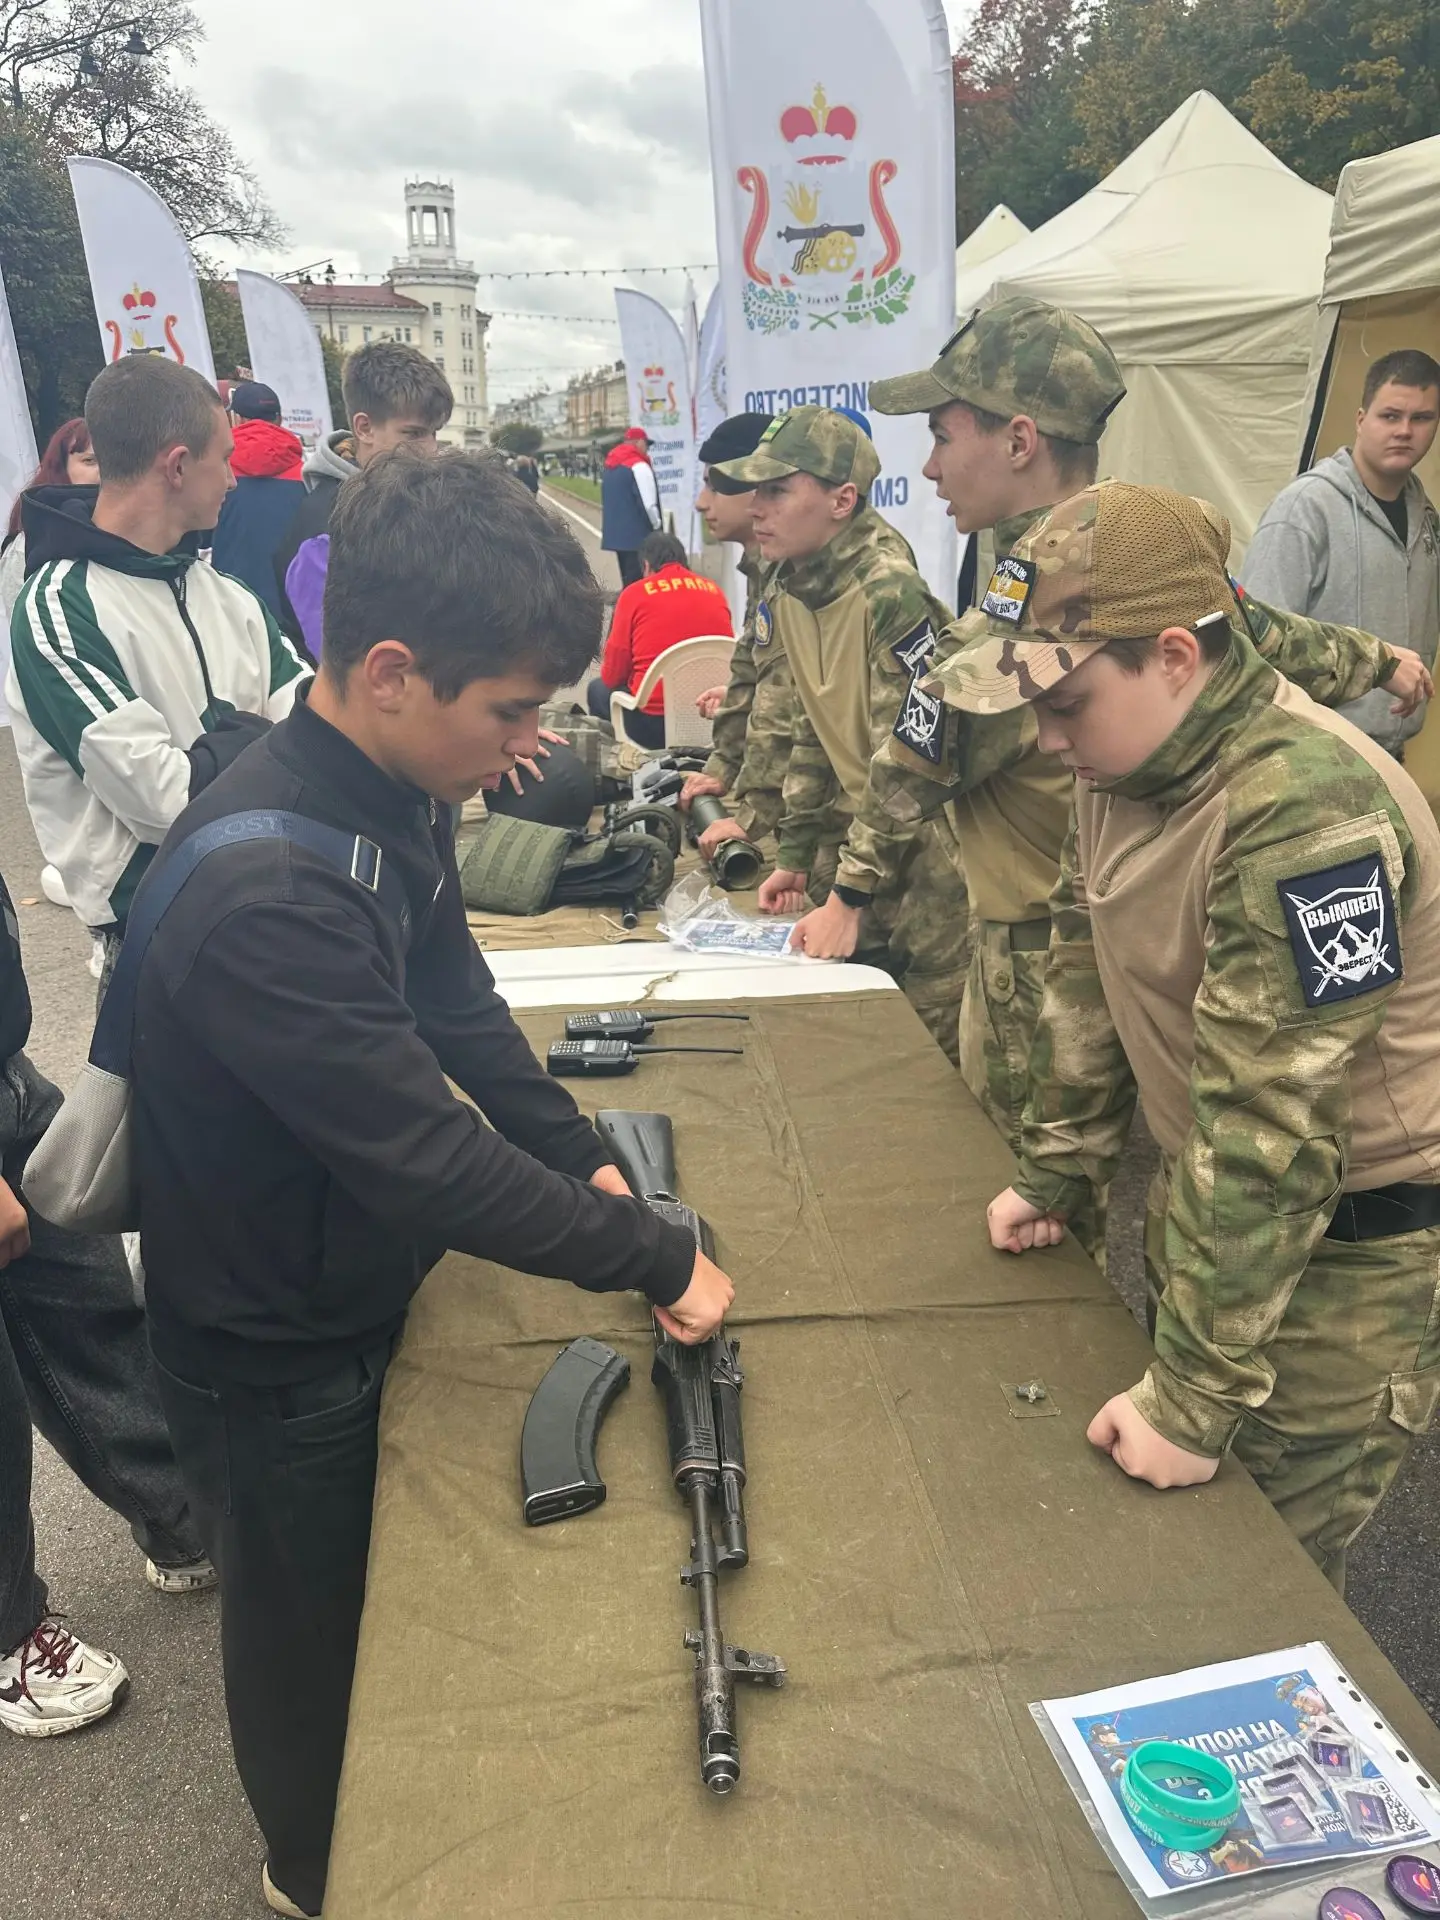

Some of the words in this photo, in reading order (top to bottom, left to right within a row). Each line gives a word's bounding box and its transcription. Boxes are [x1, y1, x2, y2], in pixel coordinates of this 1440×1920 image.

[1305, 892, 1379, 929] ВЫМПЕЛ
[1337, 954, 1374, 972] ЭВЕРЕСТ
[1249, 1719, 1293, 1743] НА
